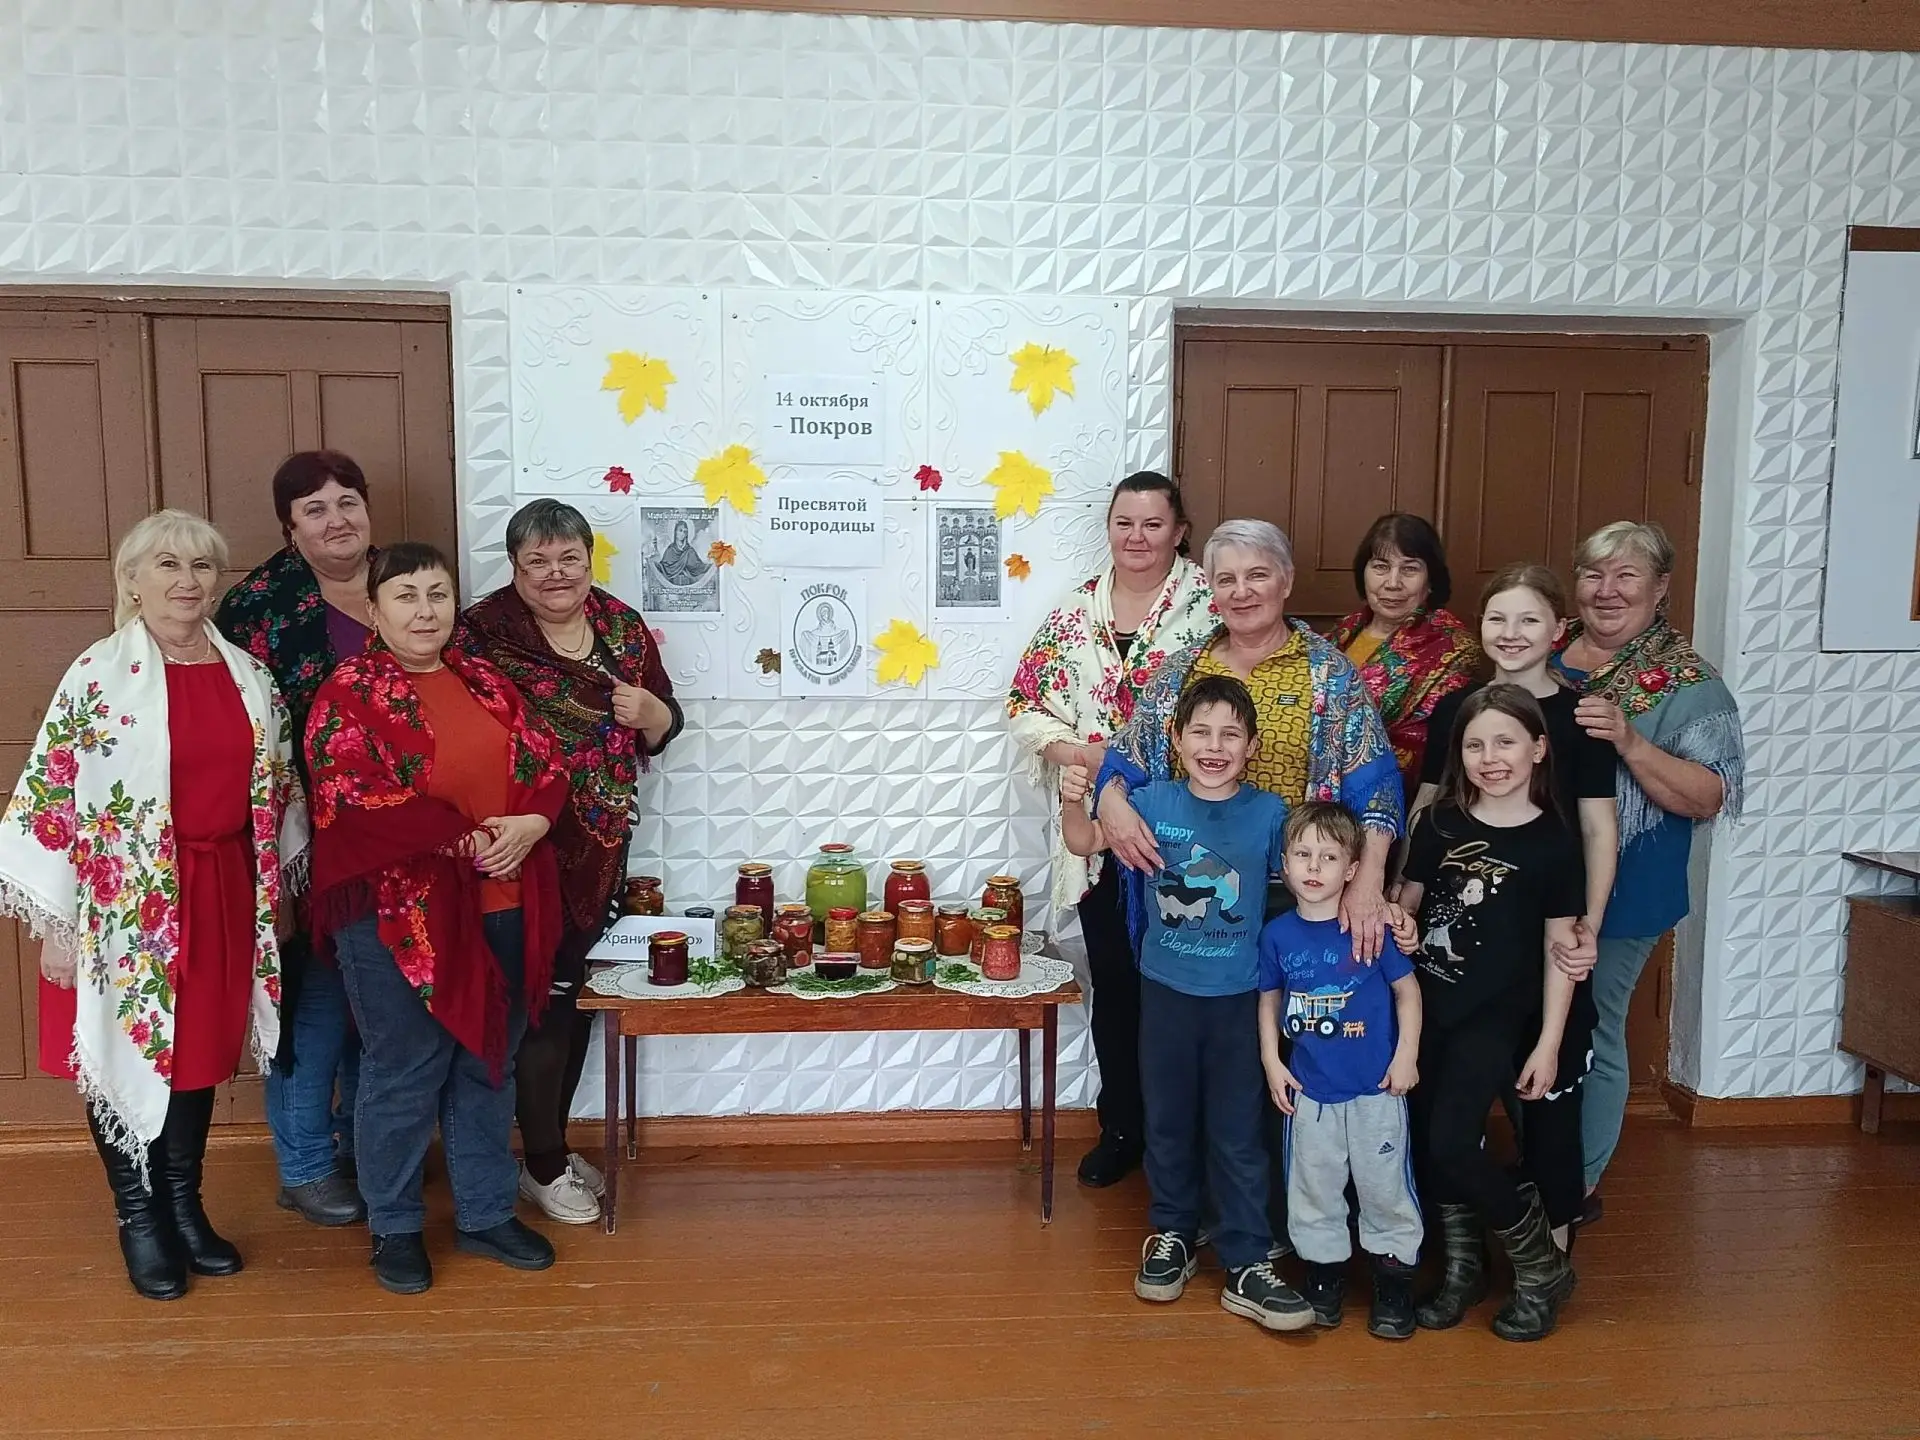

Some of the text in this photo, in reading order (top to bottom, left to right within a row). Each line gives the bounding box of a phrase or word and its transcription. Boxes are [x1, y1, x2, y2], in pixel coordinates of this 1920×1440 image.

[775, 391, 869, 411] 14 октября
[790, 416, 873, 440] Покров
[777, 496, 868, 513] Пресвятой
[769, 517, 875, 534] Богородицы
[1154, 821, 1195, 841] Happy
[1438, 840, 1510, 880] Love
[1203, 928, 1248, 939] with my
[1160, 930, 1242, 958] Elephant
